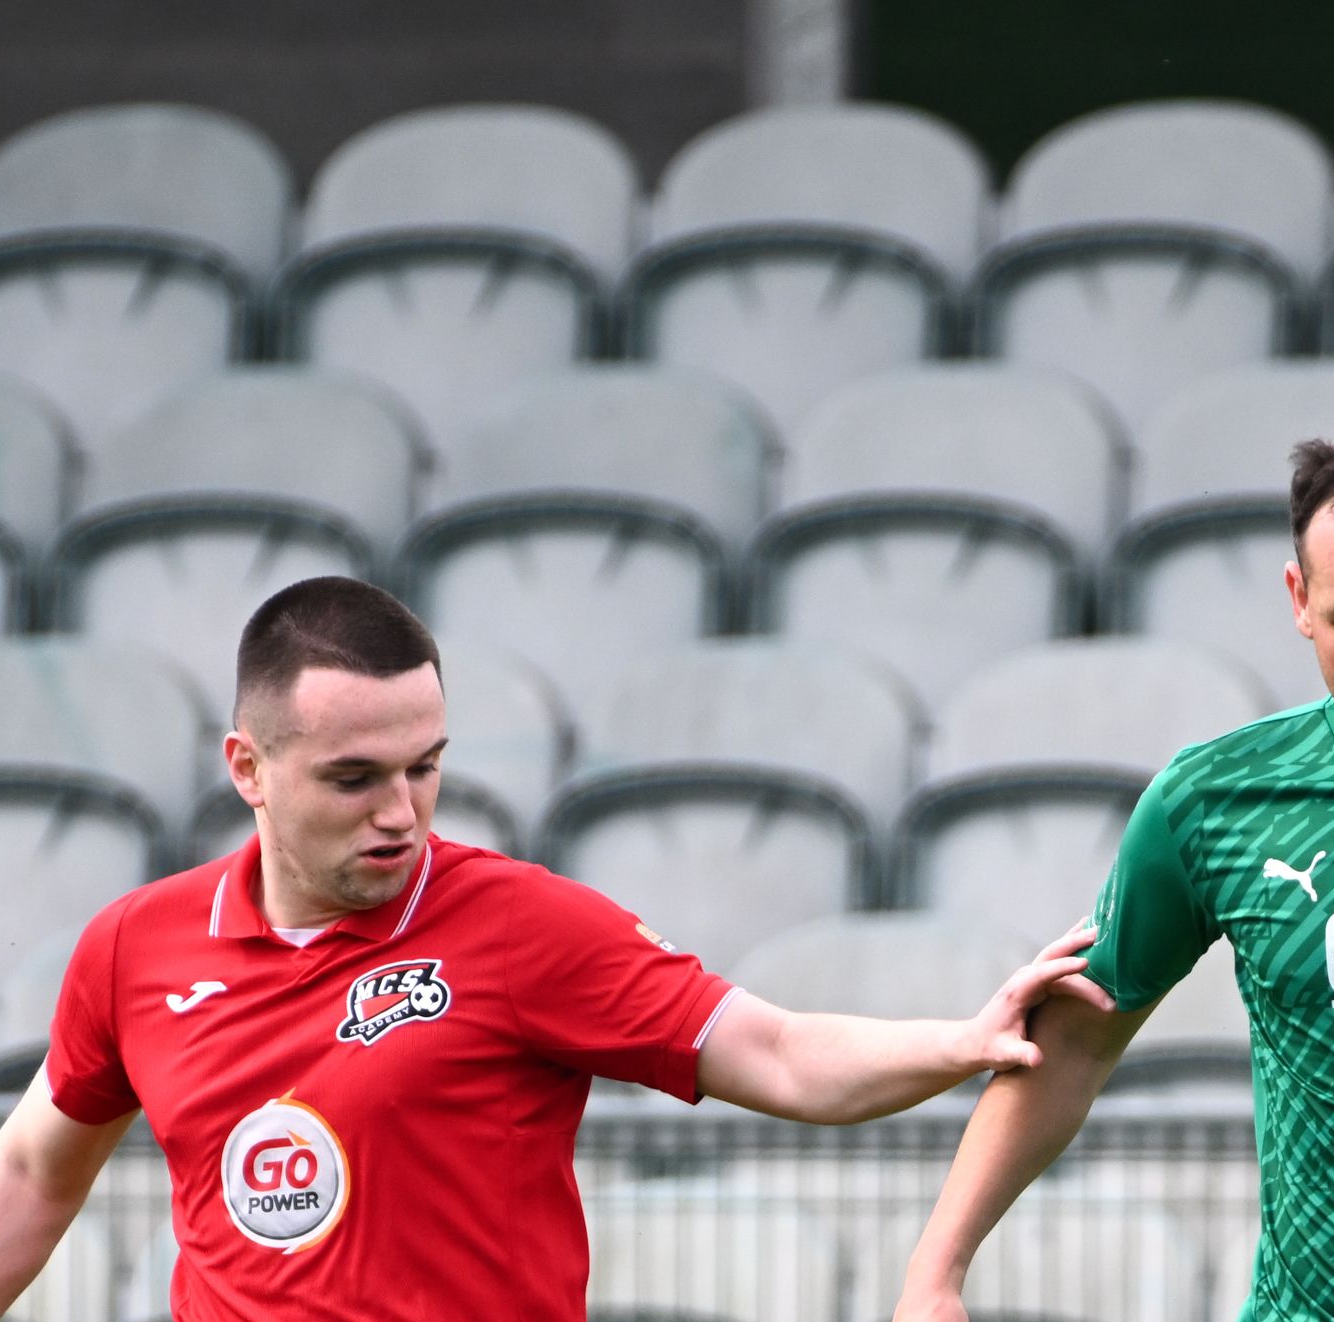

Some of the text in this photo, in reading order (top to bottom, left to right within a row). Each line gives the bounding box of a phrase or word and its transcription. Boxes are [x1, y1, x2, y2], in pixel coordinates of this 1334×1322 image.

[354, 968, 424, 1004] MCS
[349, 1007, 410, 1036] ACADEMY
[248, 1191, 320, 1214] POWER
